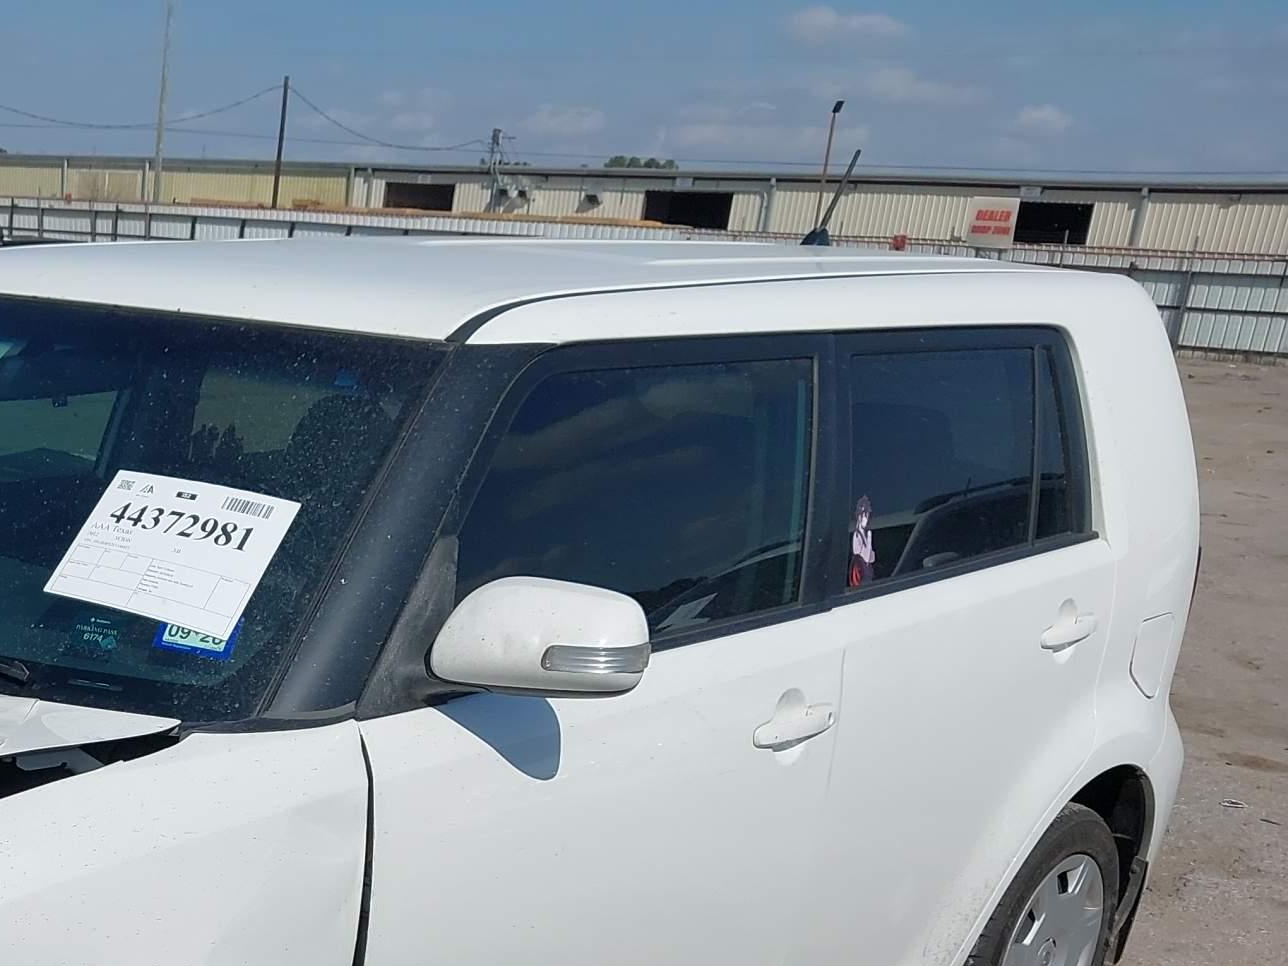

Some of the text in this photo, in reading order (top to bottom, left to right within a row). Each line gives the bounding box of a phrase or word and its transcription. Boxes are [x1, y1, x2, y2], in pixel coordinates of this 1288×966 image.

[975, 209, 1012, 221] DEALER
[110, 501, 255, 552] 44372981
[168, 624, 191, 640] 09
